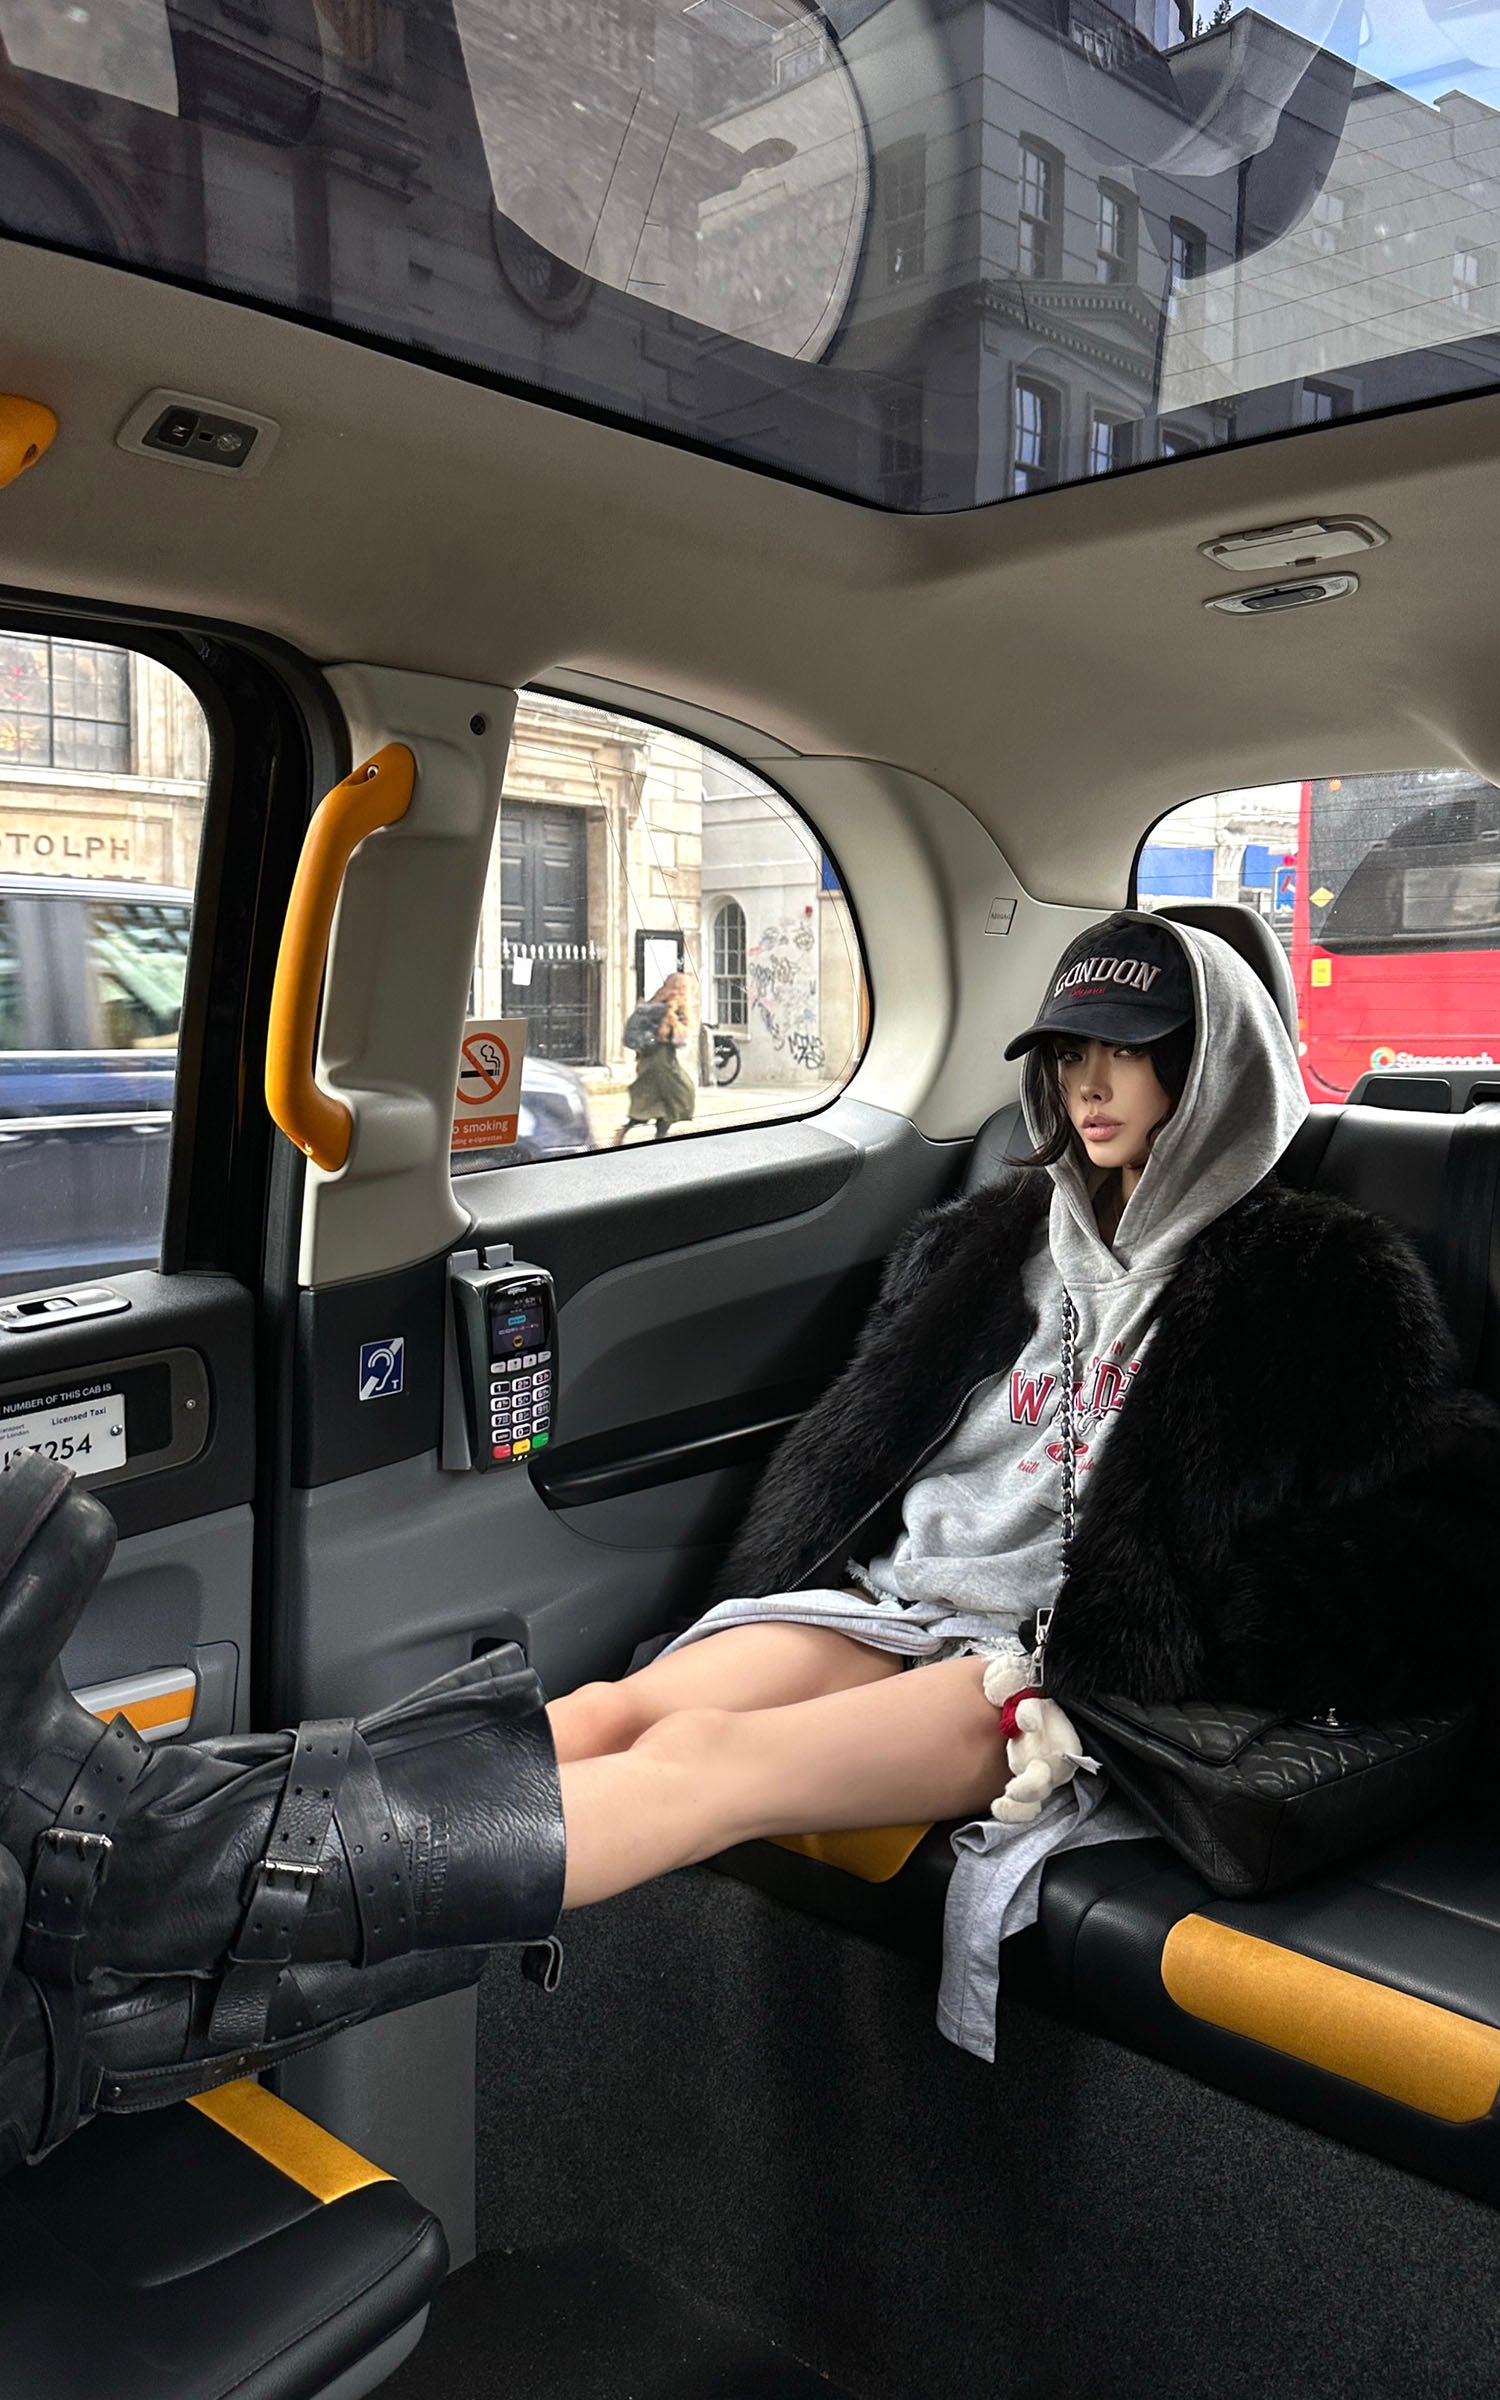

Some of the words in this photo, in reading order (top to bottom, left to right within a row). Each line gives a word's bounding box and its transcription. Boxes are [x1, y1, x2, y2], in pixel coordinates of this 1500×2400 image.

[0, 832, 130, 861] TOLPH
[1053, 956, 1162, 998] LONDON
[463, 1120, 509, 1134] smoking
[3, 1398, 45, 1414] NUMBER
[45, 1395, 59, 1405] OF
[60, 1389, 81, 1401] THIS
[82, 1386, 101, 1397] CAB
[102, 1382, 112, 1392] IS
[391, 1379, 399, 1389] T
[51, 1411, 88, 1426] Licensed
[90, 1406, 107, 1417] Taxi
[431, 1806, 449, 1919] BALENCIAG
